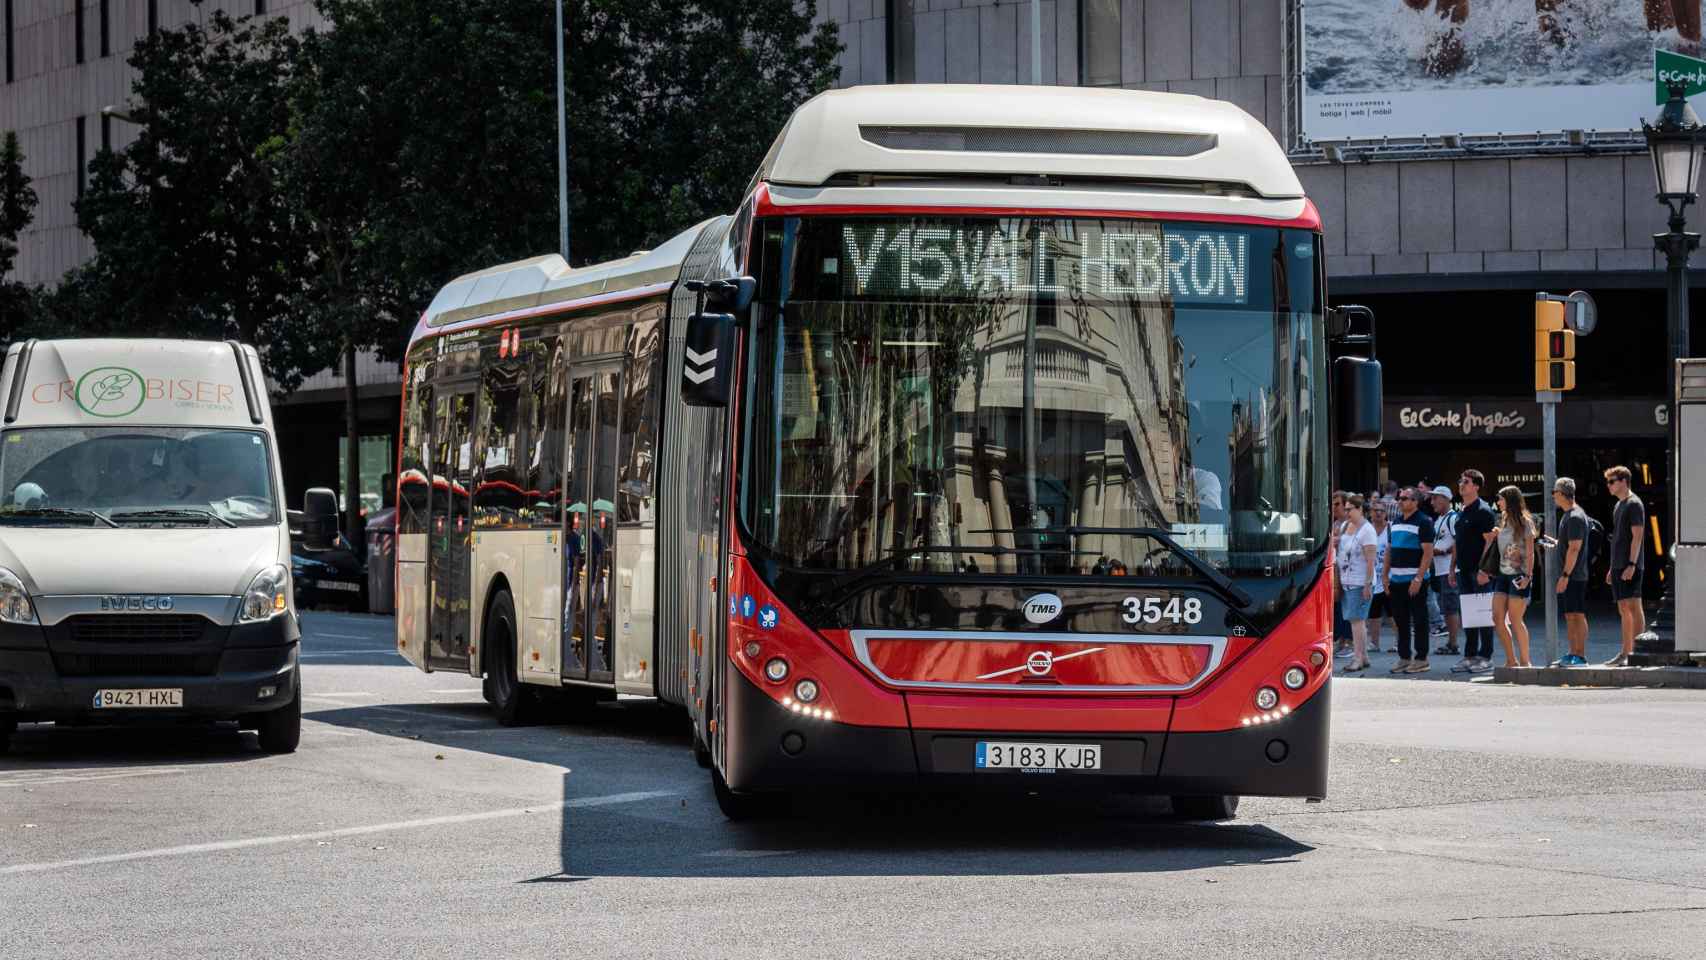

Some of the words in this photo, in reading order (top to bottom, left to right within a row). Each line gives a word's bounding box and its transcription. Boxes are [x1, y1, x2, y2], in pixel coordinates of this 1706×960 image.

[843, 227, 952, 289] V15
[956, 229, 1065, 292] VALL
[1081, 231, 1245, 297] HEBRON
[1400, 407, 1418, 428] El
[1419, 407, 1461, 428] Corte
[1463, 402, 1525, 434] Inglés
[100, 595, 174, 611] IVECO
[1030, 604, 1057, 614] TMB
[1122, 596, 1203, 625] 3548
[104, 691, 142, 705] 9421
[149, 691, 179, 705] HXL
[991, 746, 1046, 767] 3183
[1055, 747, 1096, 768] KJB
